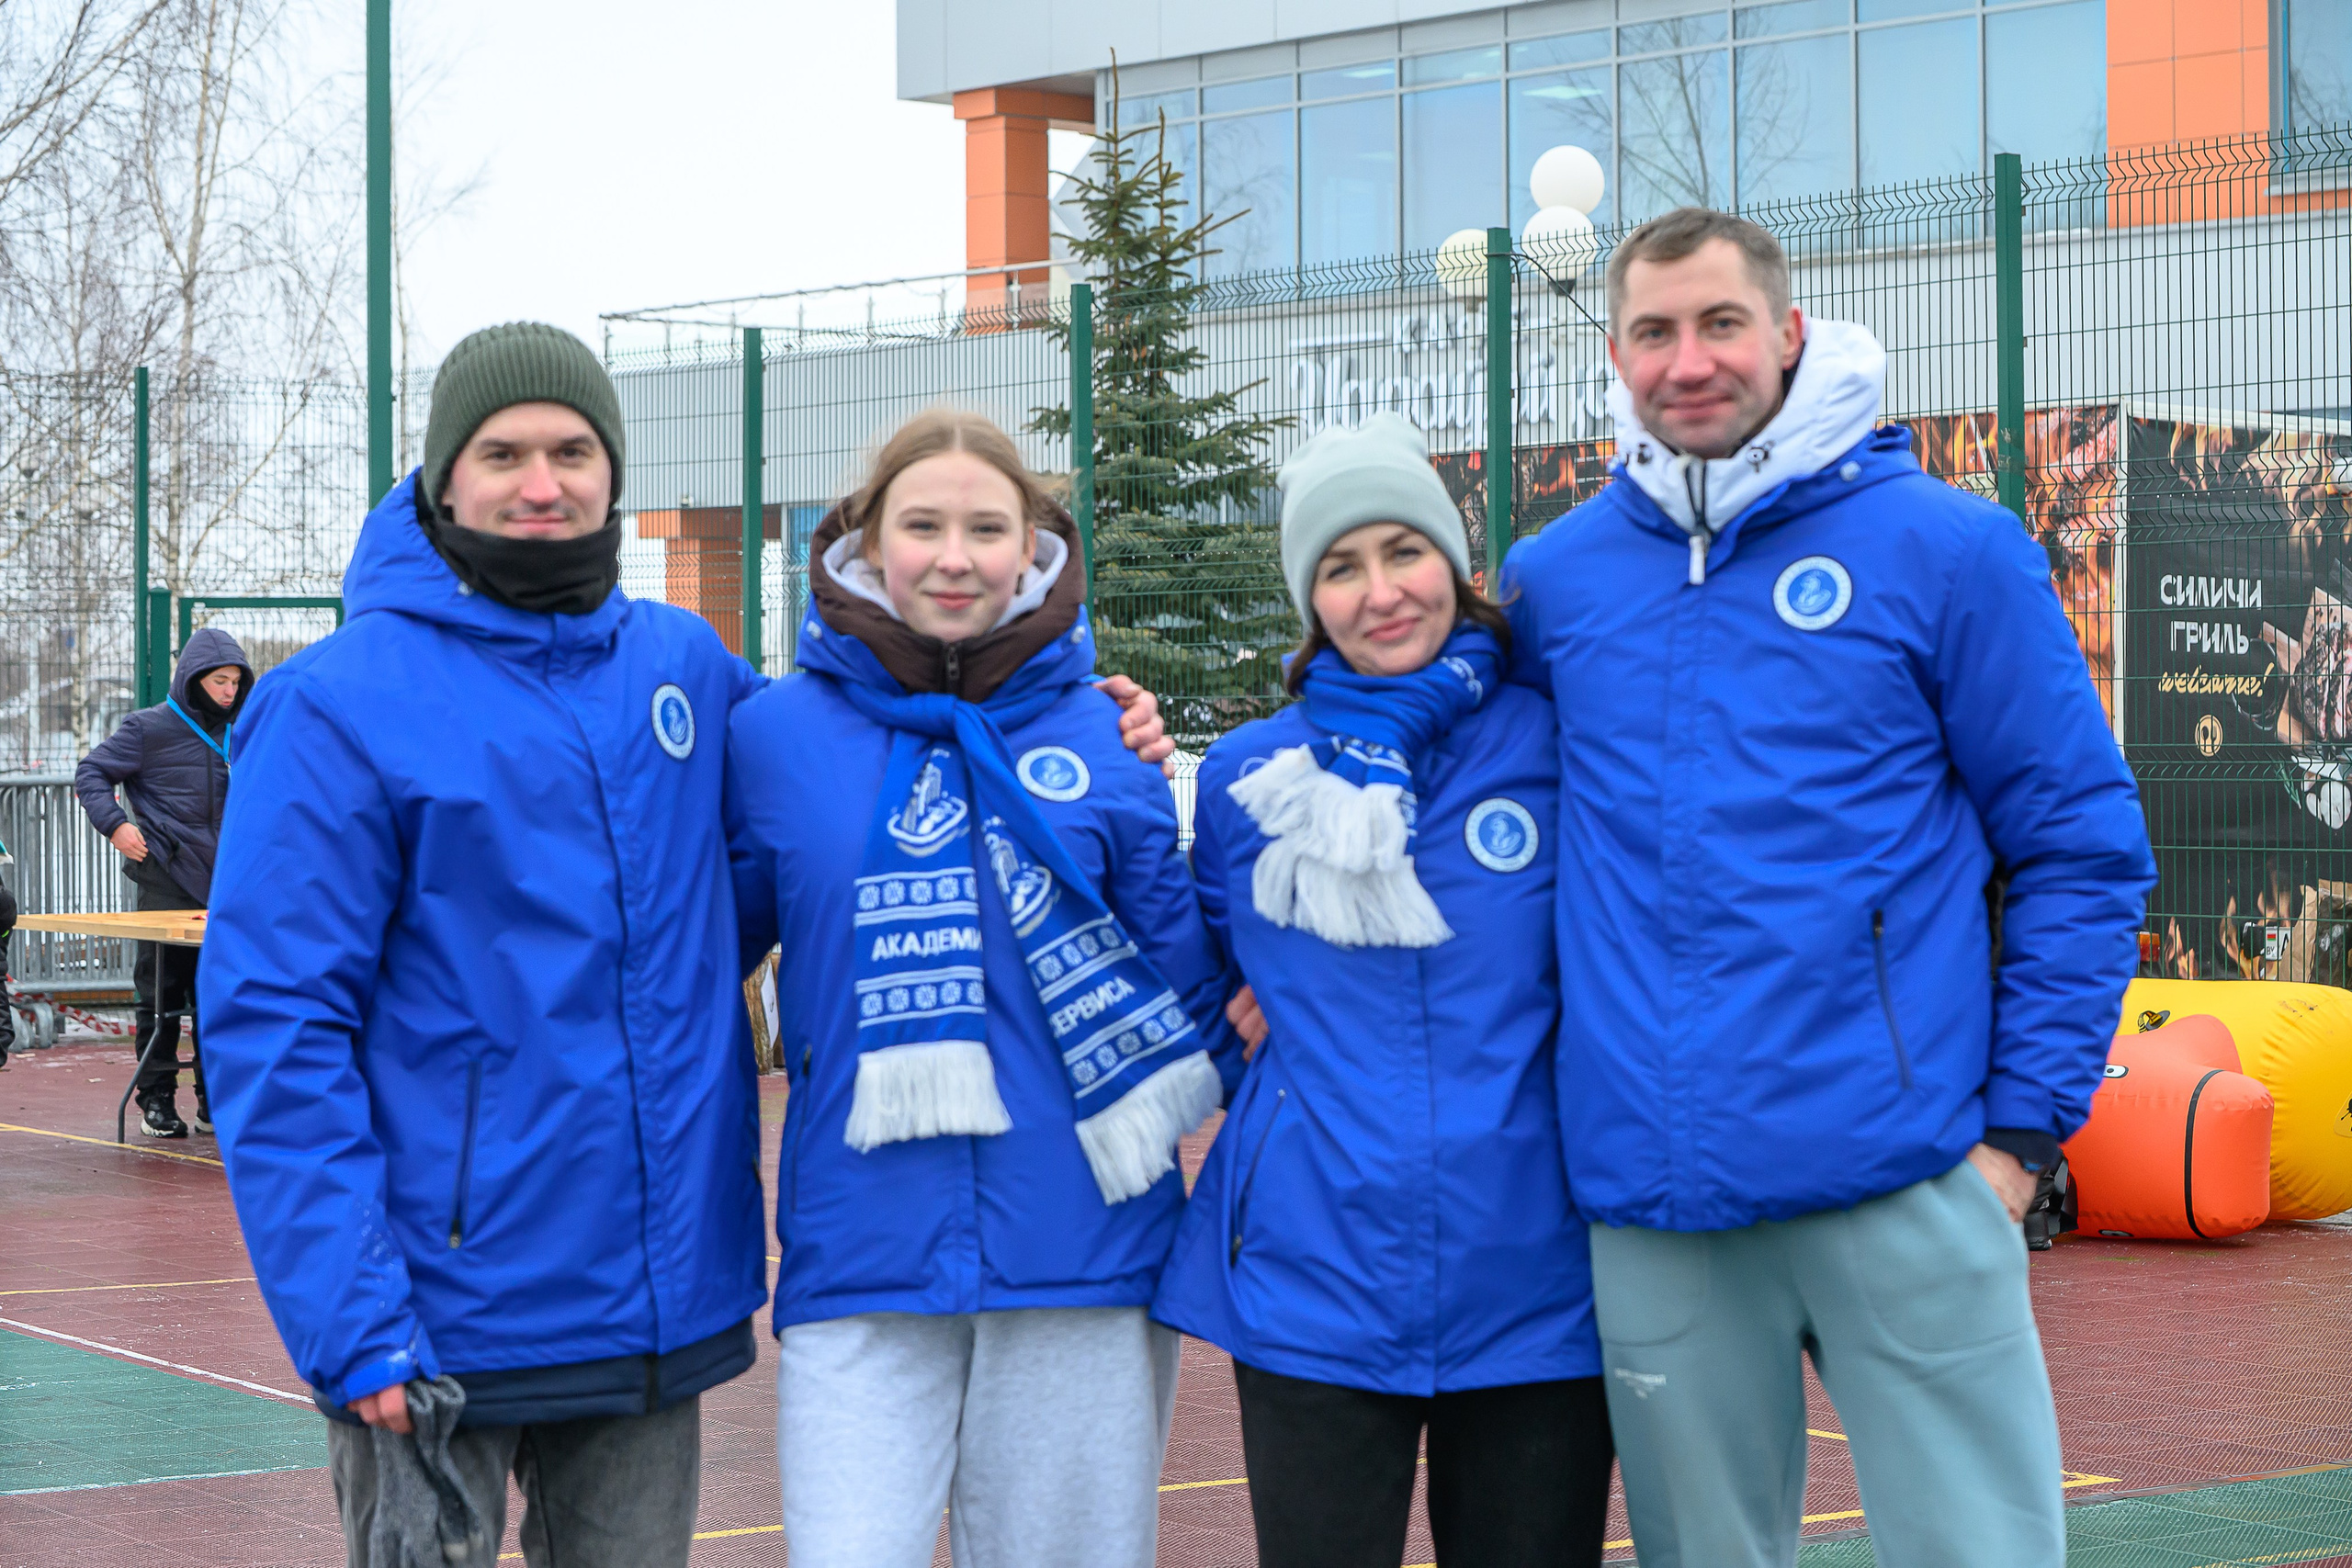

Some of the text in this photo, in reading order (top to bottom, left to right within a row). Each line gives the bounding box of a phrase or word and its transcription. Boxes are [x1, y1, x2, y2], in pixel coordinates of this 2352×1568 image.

[2160, 574, 2262, 610] СИЛИЧИ
[2170, 620, 2250, 654] ГРИЛЬ
[2158, 661, 2275, 697] welcome!
[1049, 976, 1136, 1039] ЕРВИСА
